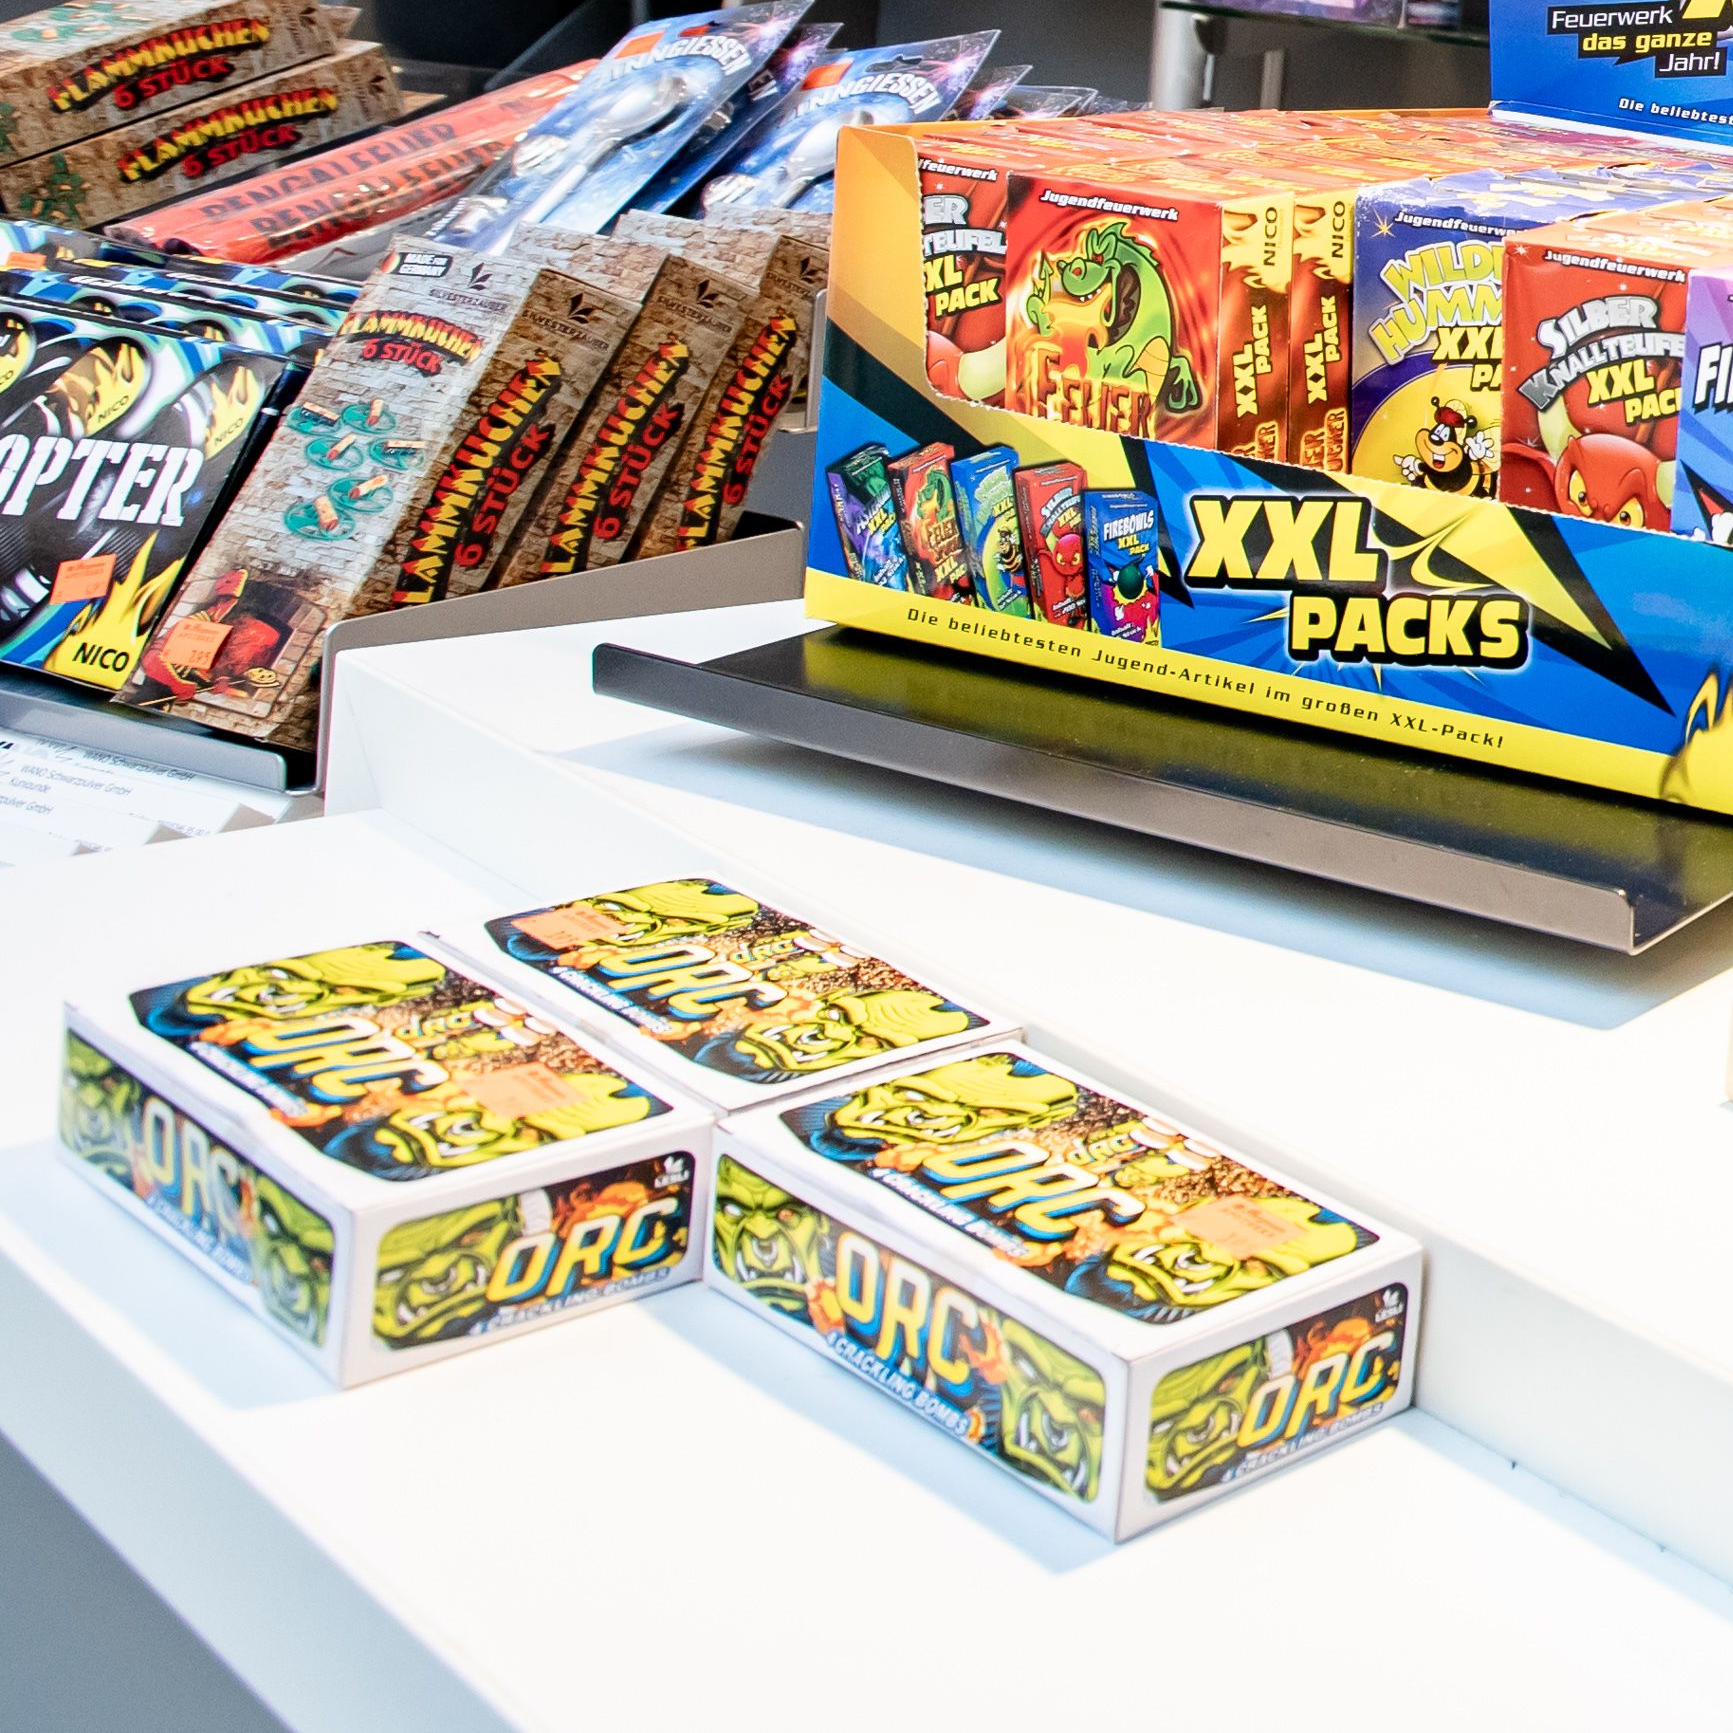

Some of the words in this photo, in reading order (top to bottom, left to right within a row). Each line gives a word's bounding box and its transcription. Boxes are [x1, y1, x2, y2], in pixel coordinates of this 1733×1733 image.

[1552, 6, 1674, 30] Feuerwerk
[1582, 29, 1628, 51] das
[1634, 29, 1713, 56] ganze
[113, 84, 133, 109] 6
[139, 55, 234, 97] STÜCK
[1659, 49, 1721, 74] Jahr!
[1618, 97, 1645, 115] Die
[181, 152, 201, 177] 6
[206, 123, 298, 168] STÜCK
[1040, 189, 1180, 223] Jugendfeuerwerk
[1331, 200, 1346, 260] NICO
[404, 252, 433, 265] MADE
[1263, 206, 1278, 267] NICO
[1544, 249, 1686, 284] Jugendfeuerwerk
[401, 263, 447, 278] GERMANY
[935, 278, 1000, 318] PACK
[363, 337, 379, 362] 6
[382, 340, 444, 377] STÜCK
[1252, 304, 1273, 375] PACK
[1323, 295, 1343, 364] PACK
[1537, 297, 1660, 360] SILBER
[1232, 342, 1260, 419] XXL
[1303, 333, 1330, 406] XXL
[1588, 362, 1656, 406] XXL
[97, 394, 130, 423] NICO
[213, 416, 245, 447] NICO
[722, 480, 744, 506] 6
[733, 376, 792, 481] STÜCK
[455, 542, 478, 569] 6
[477, 422, 555, 543] STÜCK
[593, 514, 619, 541] 6
[607, 402, 683, 515] STÜCK
[1103, 509, 1155, 541] FIREBOWLS
[1188, 498, 1378, 583] XXL
[72, 641, 130, 673] NICO
[1291, 599, 1522, 657] PACKS
[907, 607, 939, 627] Die
[948, 617, 1083, 658] beliebtesten
[1090, 648, 1256, 696] Jugend-Artikel
[1266, 684, 1292, 701] im
[1301, 692, 1381, 726] großen
[1389, 710, 1505, 750] XXL-Pack!
[601, 944, 789, 1021] ORC
[246, 1014, 451, 1107] ORC
[922, 1140, 1148, 1241] ORC
[484, 1197, 680, 1303] ORC
[834, 1231, 981, 1386] ORC
[836, 1336, 916, 1403] CRACKLING
[914, 1384, 970, 1438] BOMBS
[1237, 1330, 1395, 1449] ORC
